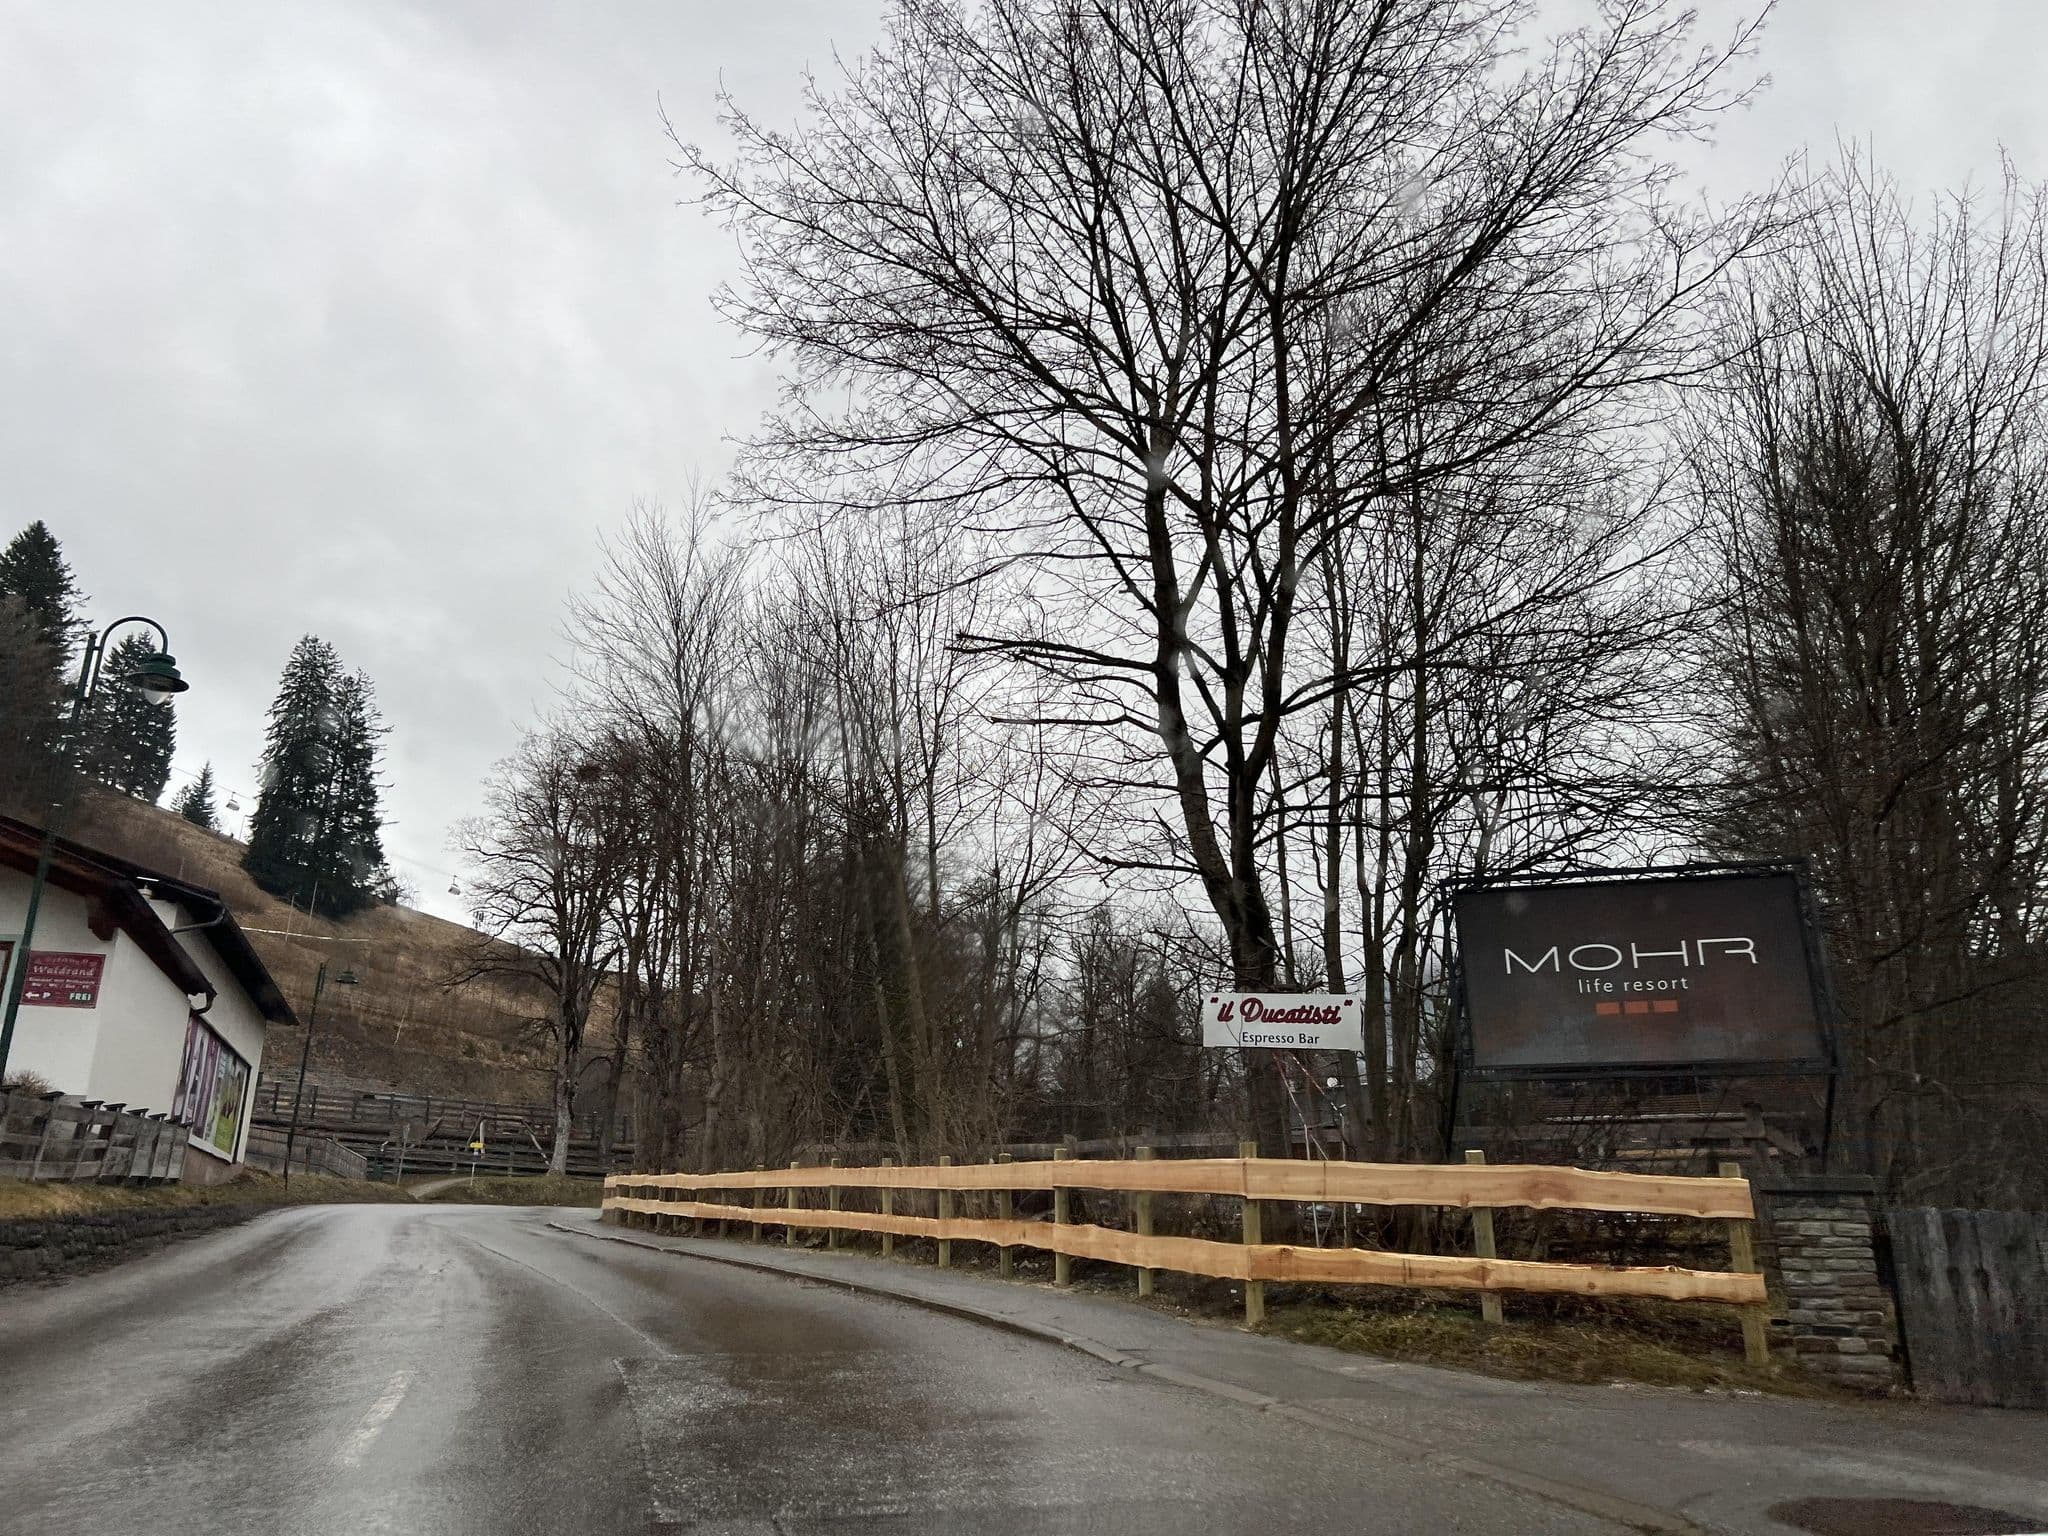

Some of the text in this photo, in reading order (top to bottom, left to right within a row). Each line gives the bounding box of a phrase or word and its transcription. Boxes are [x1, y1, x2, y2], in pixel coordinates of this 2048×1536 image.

[1504, 937, 1758, 974] MOHR
[1578, 976, 1689, 993] life resort
[69, 992, 92, 1001] FREI
[1242, 1032, 1321, 1046] Espresso Bar
